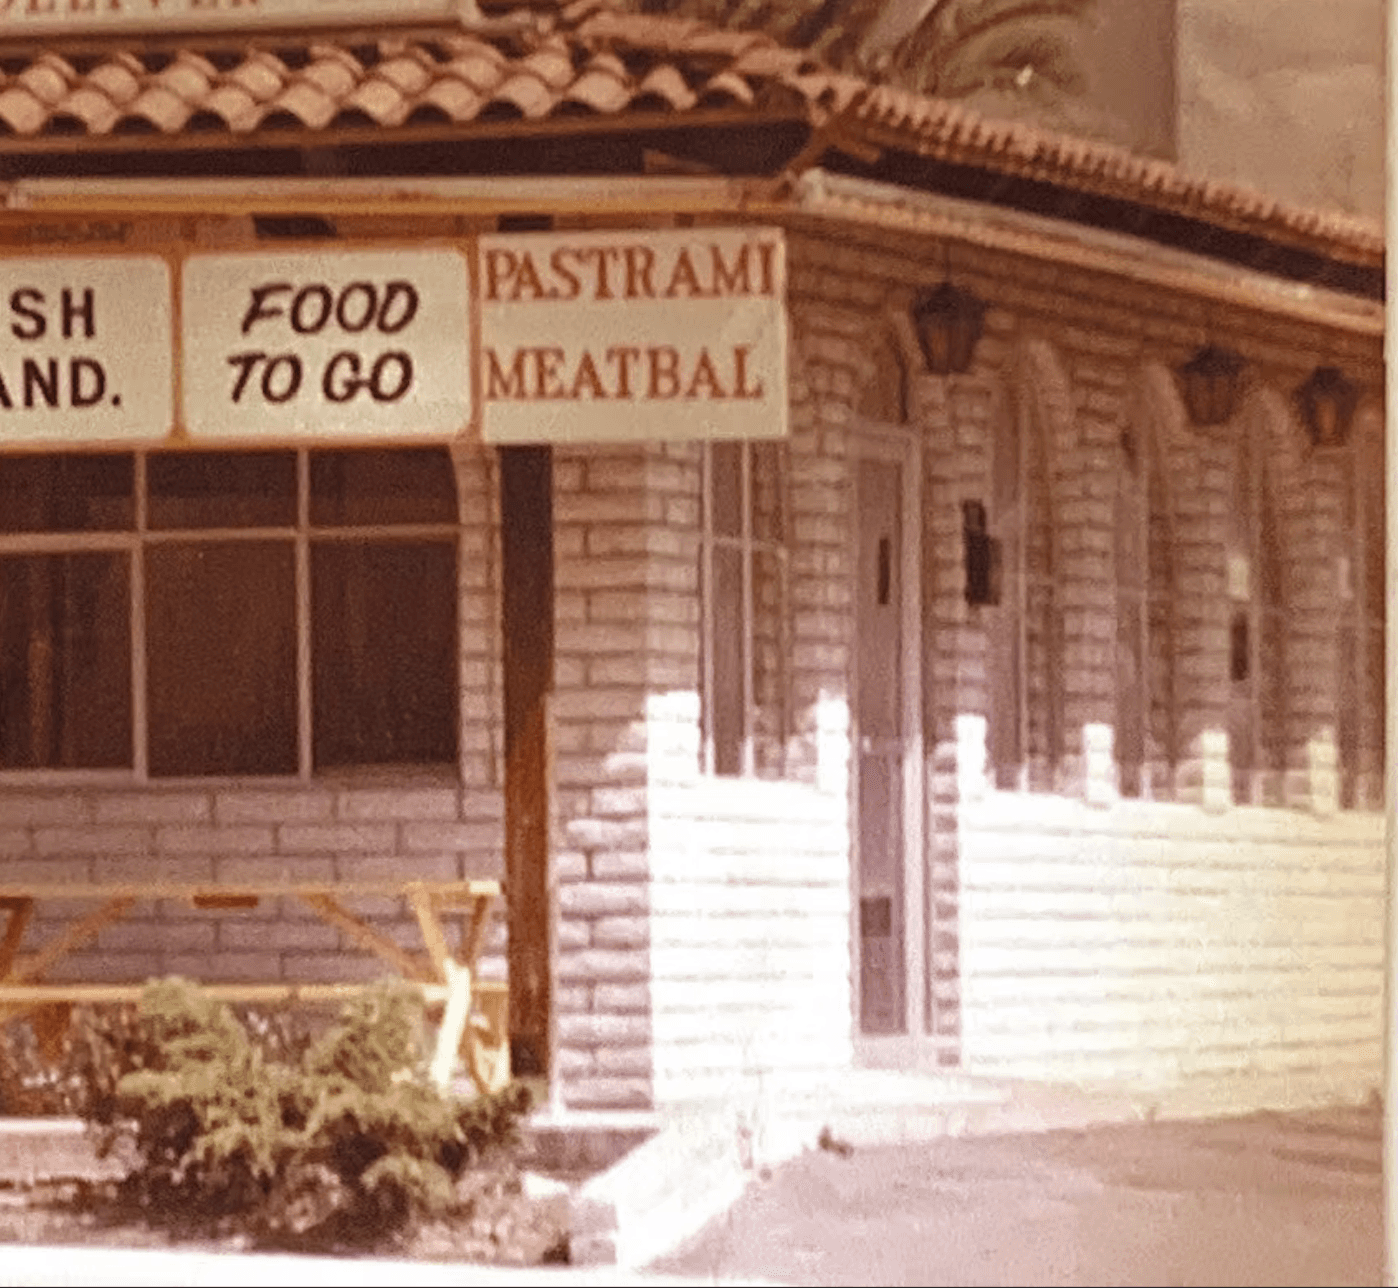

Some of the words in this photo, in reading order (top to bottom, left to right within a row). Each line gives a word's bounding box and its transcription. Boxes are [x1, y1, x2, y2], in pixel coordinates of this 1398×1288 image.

[484, 244, 776, 300] PASTRAMI
[242, 281, 419, 335] FOOD
[227, 351, 303, 403] TO
[322, 351, 414, 402] GO
[484, 346, 764, 400] MEATBAL
